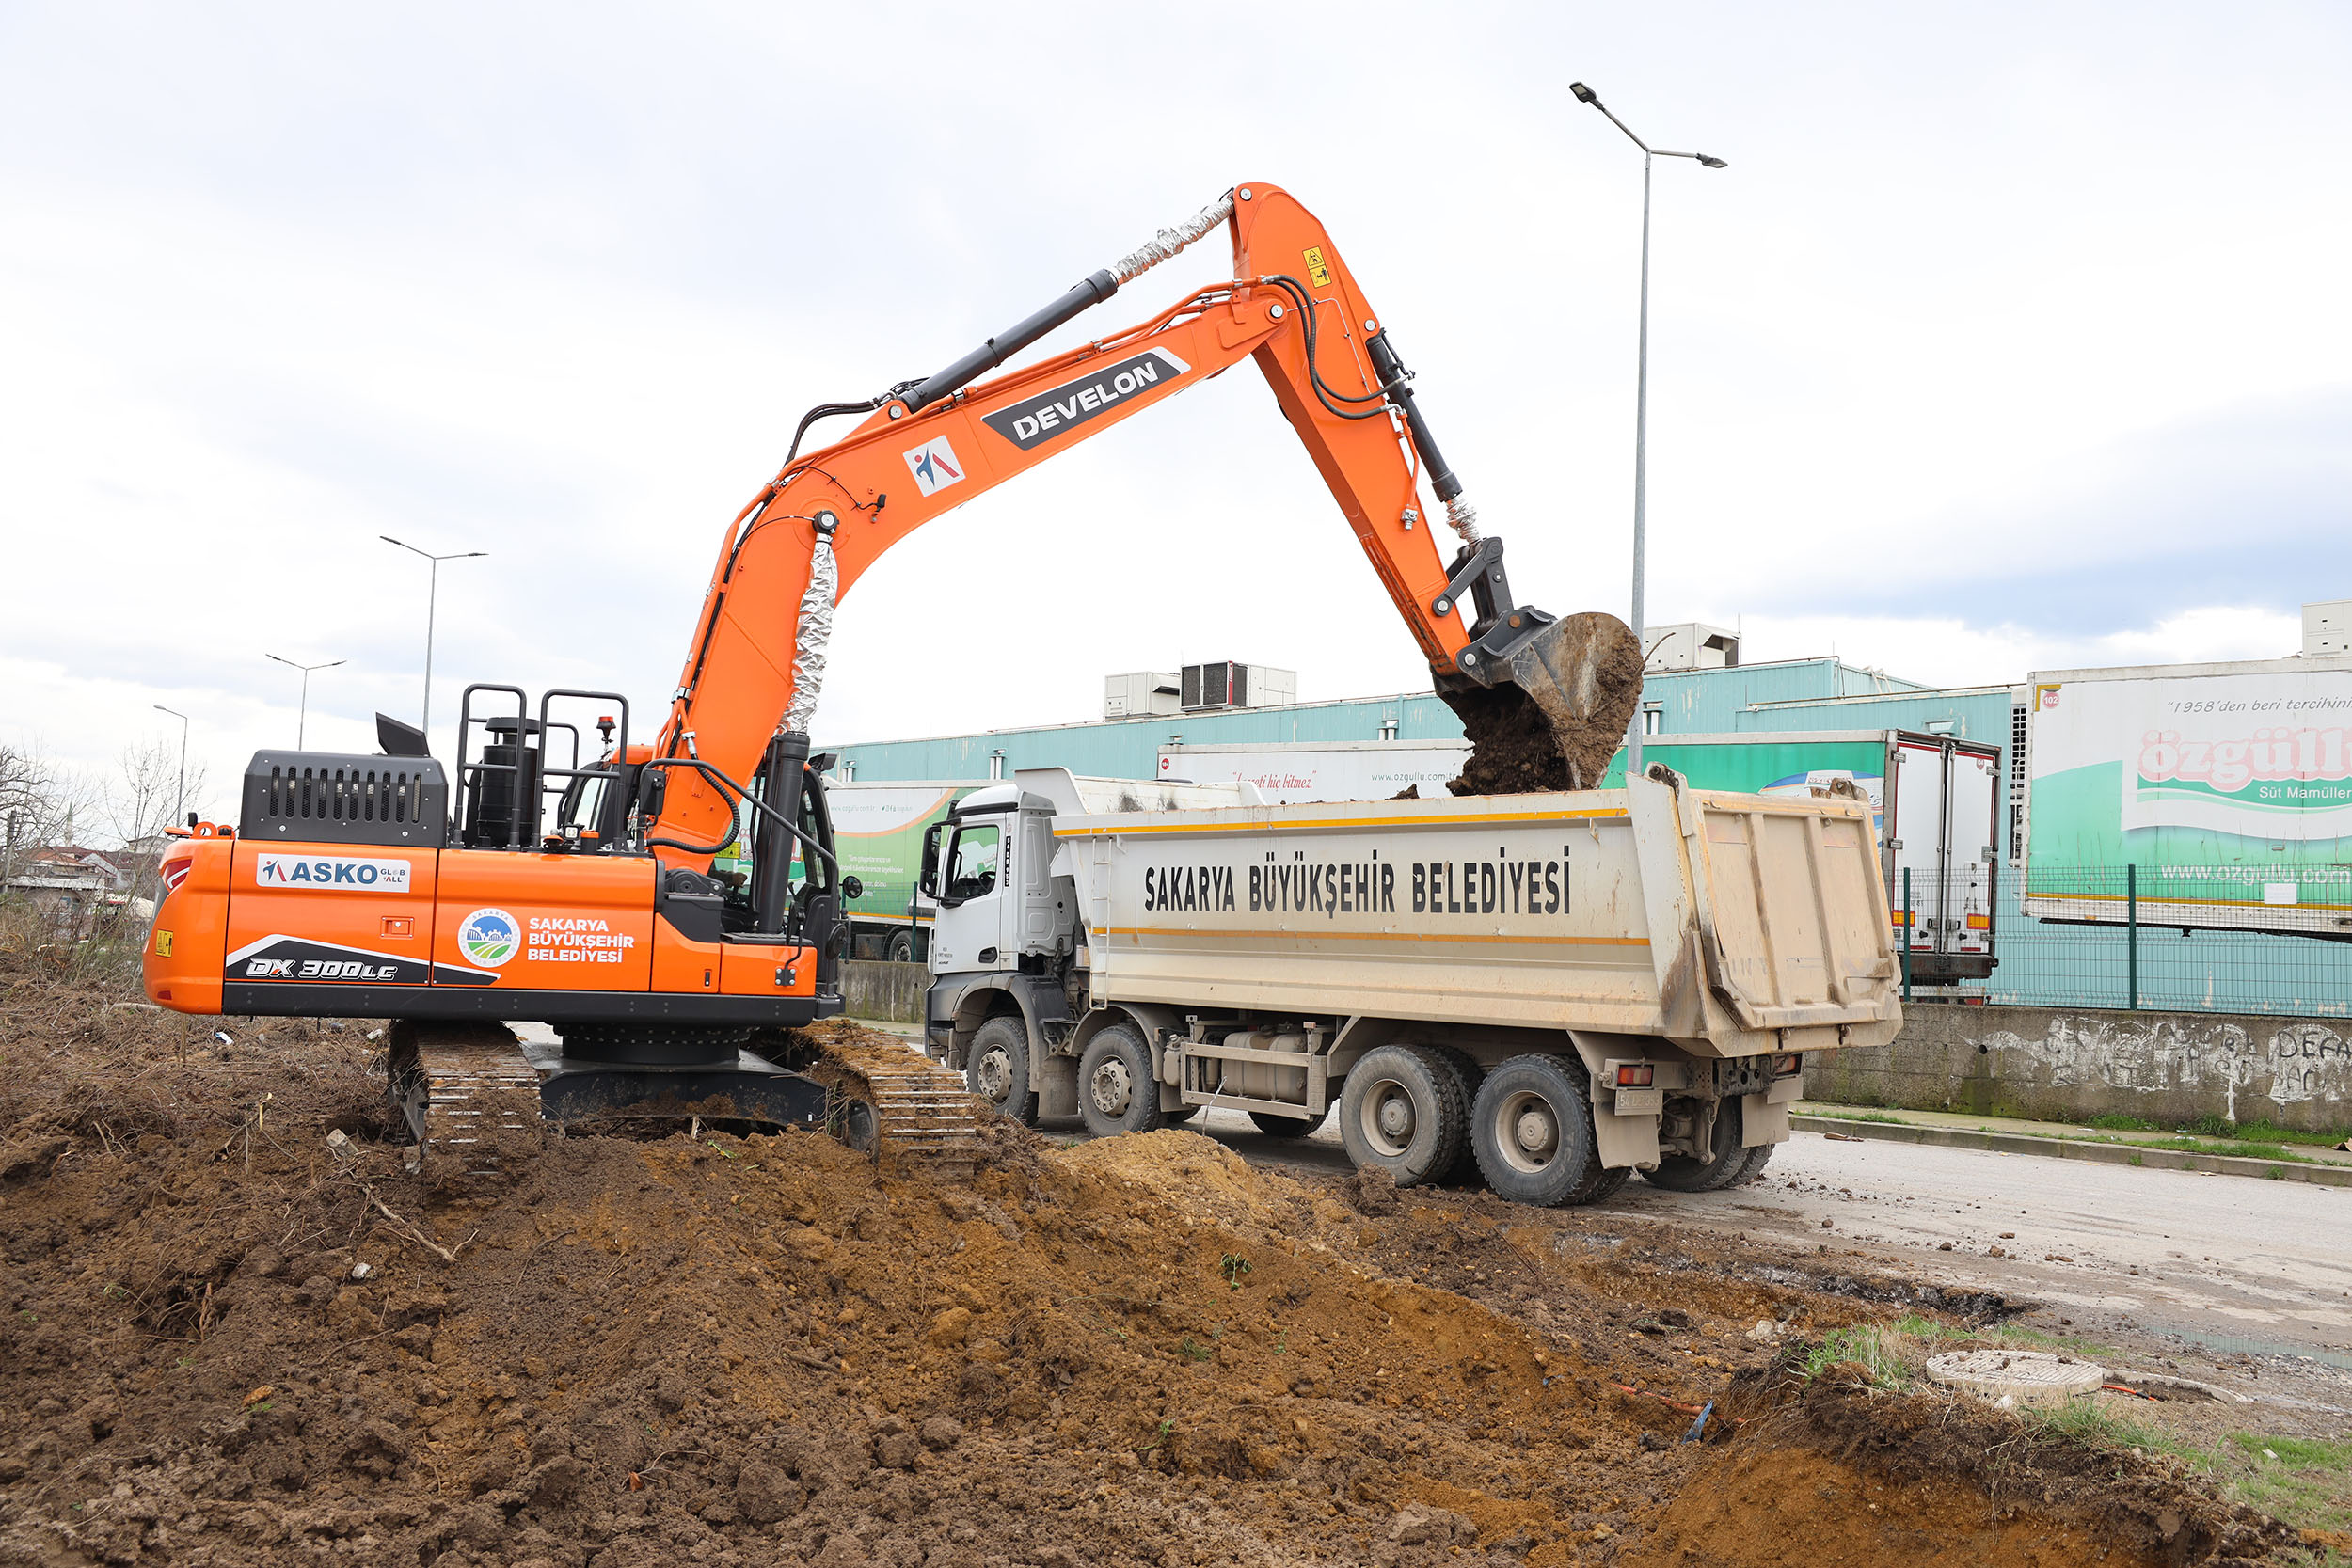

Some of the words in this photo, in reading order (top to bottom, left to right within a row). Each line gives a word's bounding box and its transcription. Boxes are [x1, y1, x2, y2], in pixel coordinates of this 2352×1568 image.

[1012, 361, 1159, 441] DEVELON
[2044, 695, 2058, 705] 102
[2251, 698, 2283, 711] beri
[1267, 774, 1281, 792] hiç
[1371, 771, 1457, 784] www.ozgullu.com.tr
[2259, 785, 2282, 799] Süt
[290, 862, 378, 884] ASKO
[1145, 865, 1235, 911] SAKARYA
[1249, 848, 1395, 919] BÜYÜKŞEHİR
[1412, 845, 1570, 914] BELEDİYESİ
[529, 918, 609, 932] SAKARYA
[529, 931, 634, 949] BÜYÜKŞEHİR
[527, 947, 623, 963] BELEDİYESİ
[246, 958, 296, 978] DX
[298, 960, 399, 980] 300LC
